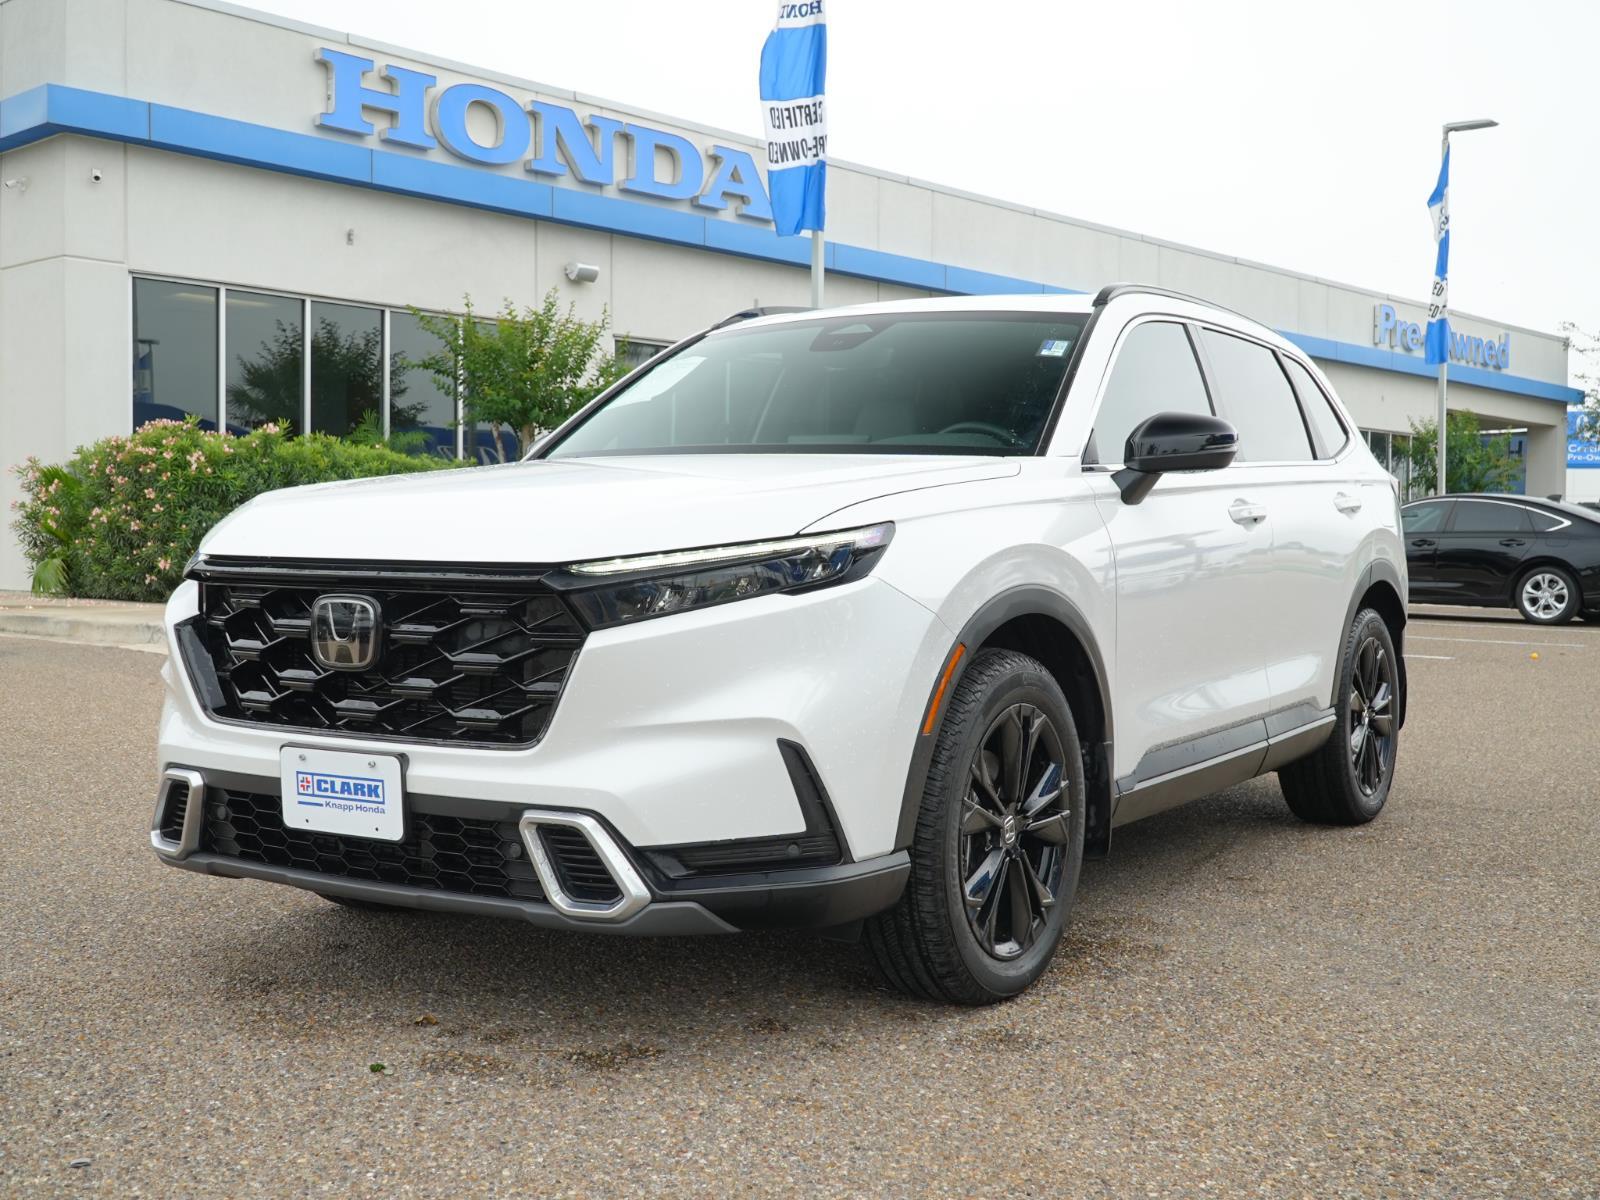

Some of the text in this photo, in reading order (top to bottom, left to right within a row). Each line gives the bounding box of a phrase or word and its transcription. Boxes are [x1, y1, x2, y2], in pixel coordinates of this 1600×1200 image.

[314, 47, 775, 222] HONDA
[316, 778, 381, 799] CLARK
[325, 801, 386, 814] Knapp Honda
